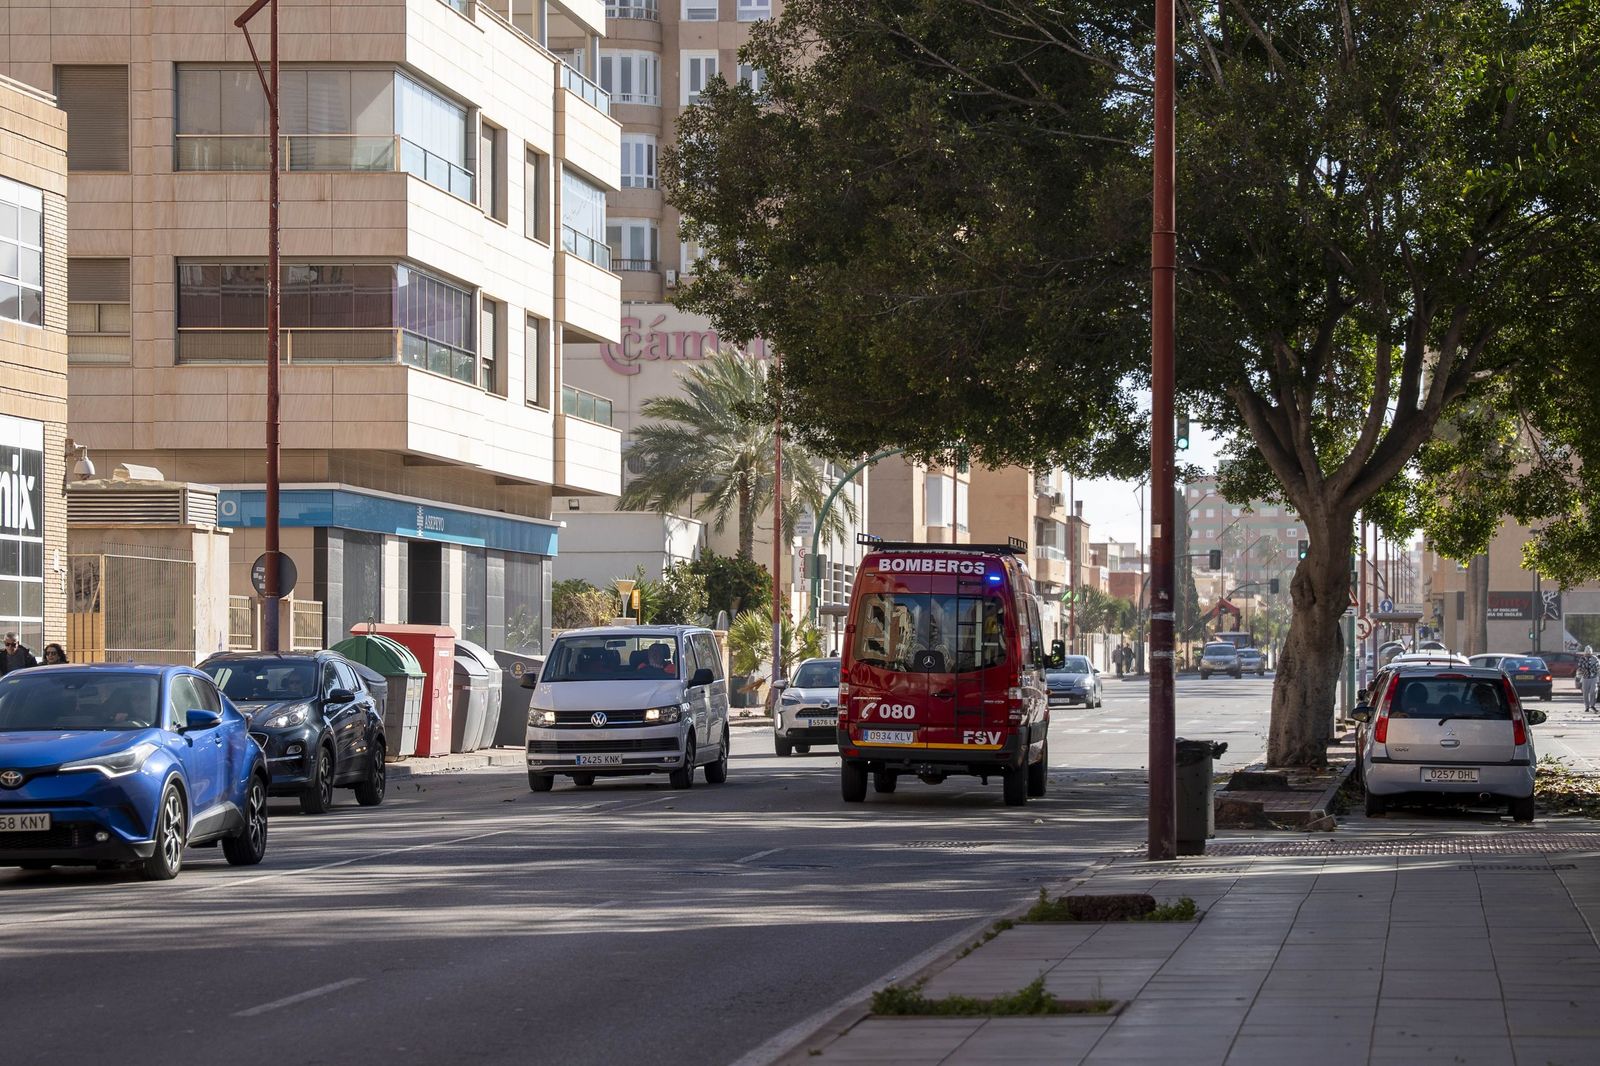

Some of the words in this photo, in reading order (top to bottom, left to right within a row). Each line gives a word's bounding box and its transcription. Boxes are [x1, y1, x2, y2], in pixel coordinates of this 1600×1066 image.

[424, 514, 445, 532] ASEPEYO
[878, 558, 986, 575] BOMBEROS
[879, 704, 915, 720] 080
[870, 730, 892, 741] 0934
[894, 730, 912, 741] KLV
[963, 730, 1002, 745] FSV
[582, 756, 602, 764] 2425
[604, 755, 620, 764] KNK
[1430, 770, 1455, 779] 0257
[1457, 770, 1476, 779] DHL
[0, 817, 15, 830] 58
[20, 815, 46, 829] KNY
